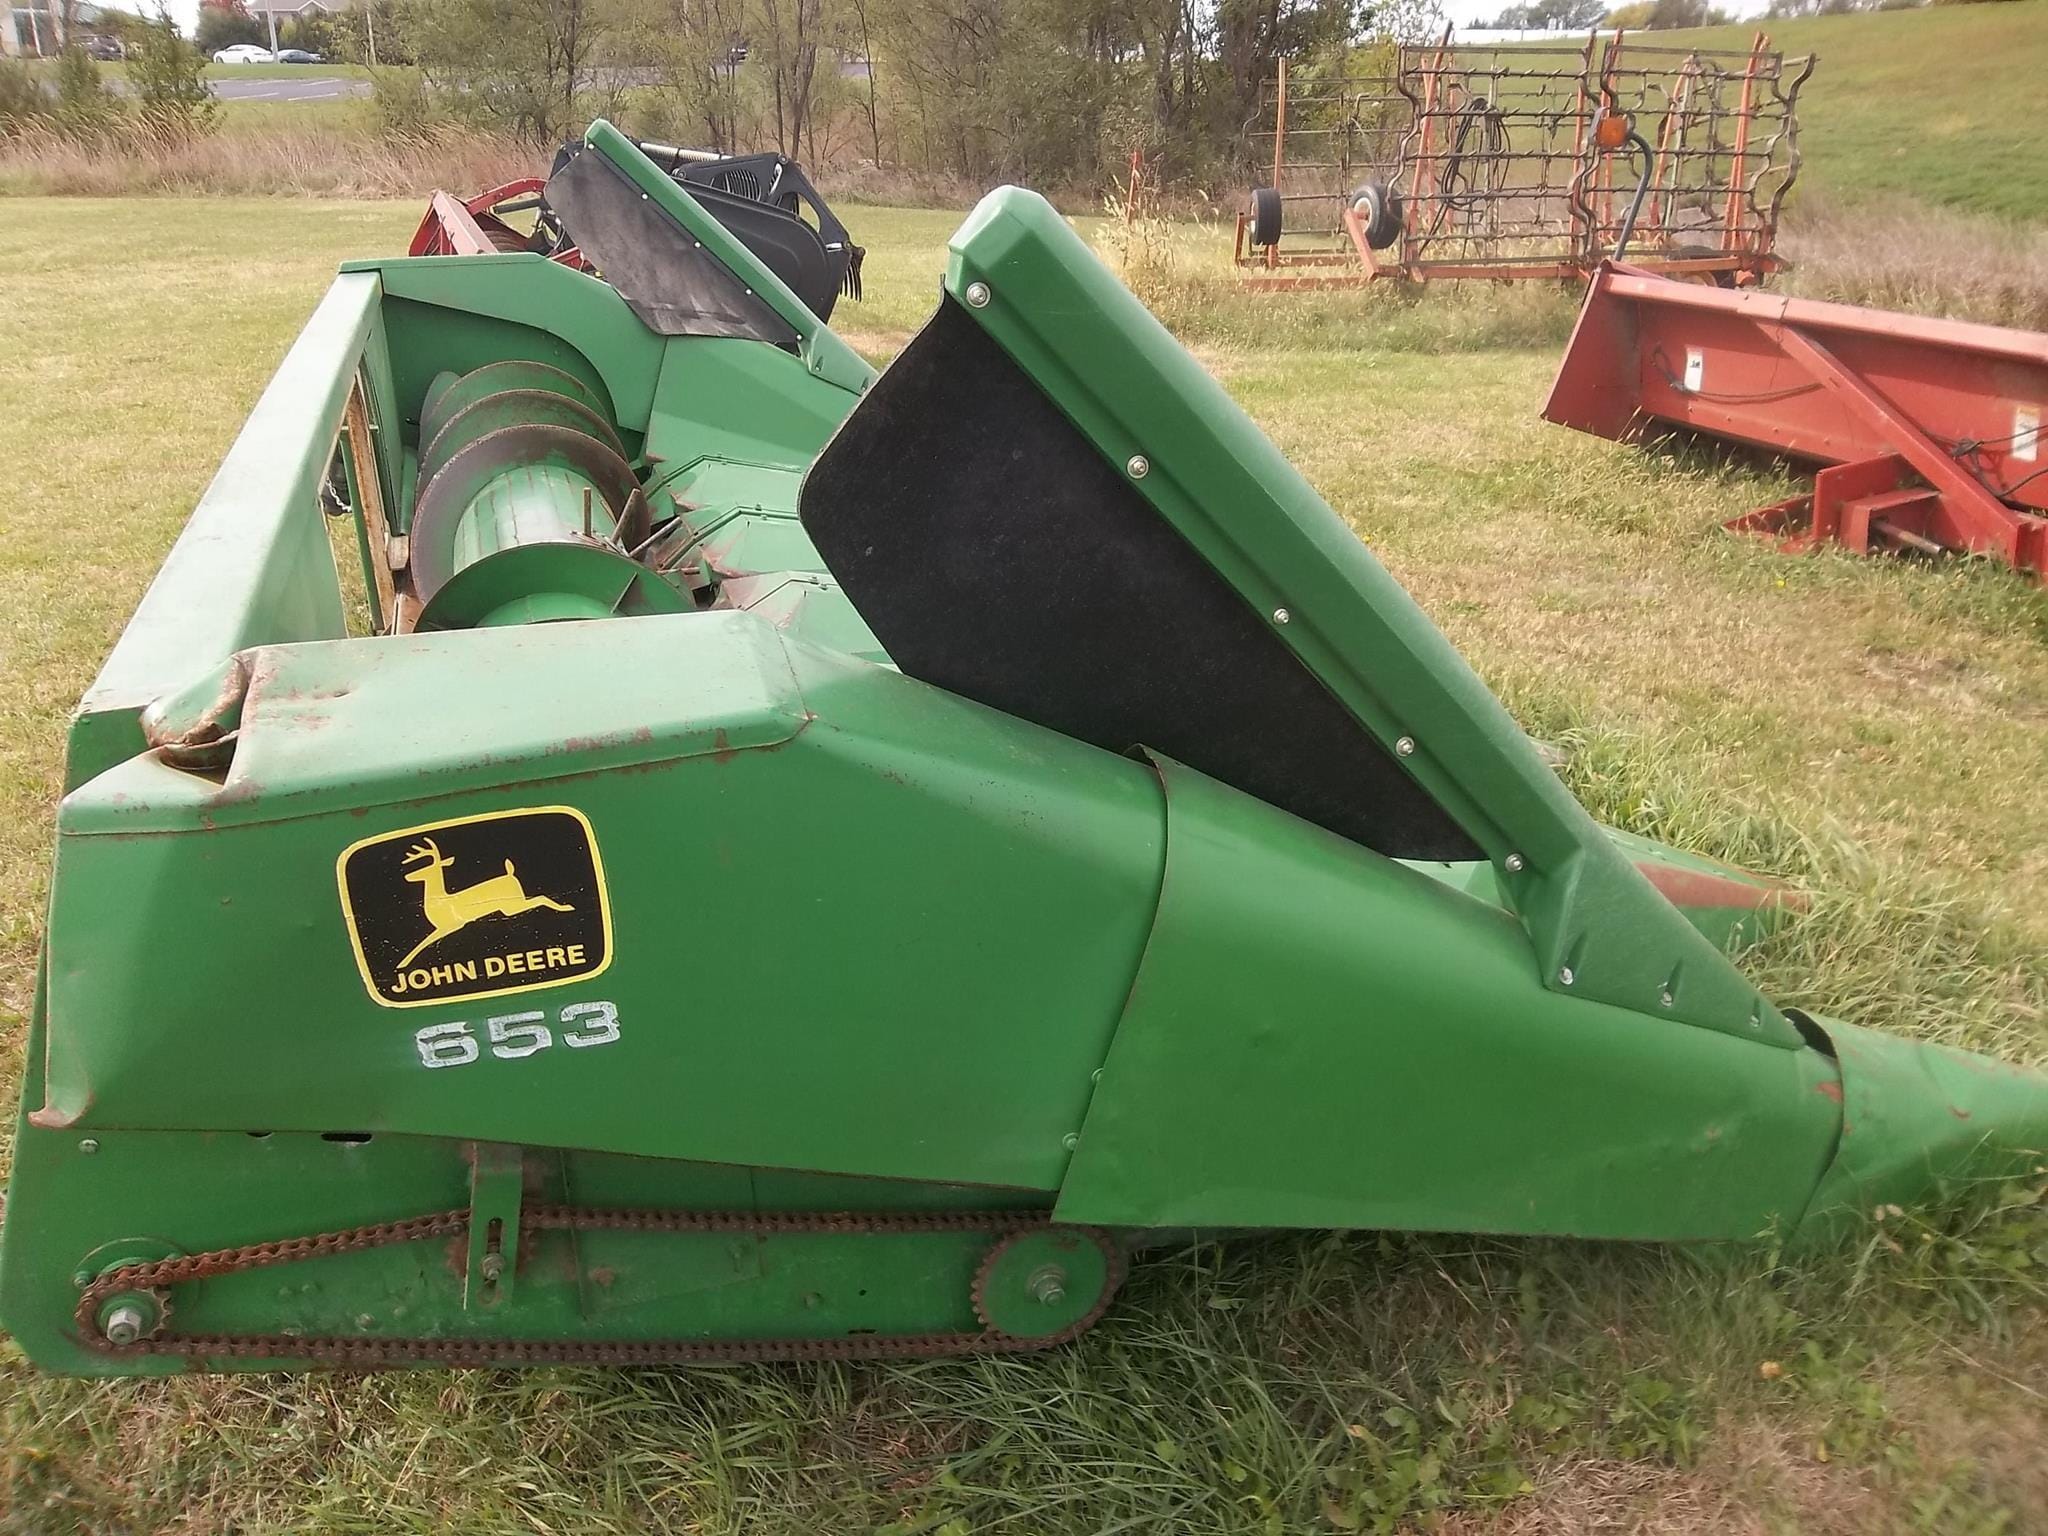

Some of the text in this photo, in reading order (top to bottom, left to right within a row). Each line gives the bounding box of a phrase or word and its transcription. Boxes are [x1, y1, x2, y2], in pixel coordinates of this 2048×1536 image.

[391, 944, 587, 994] JOHN DEERE
[414, 1000, 621, 1069] 653
